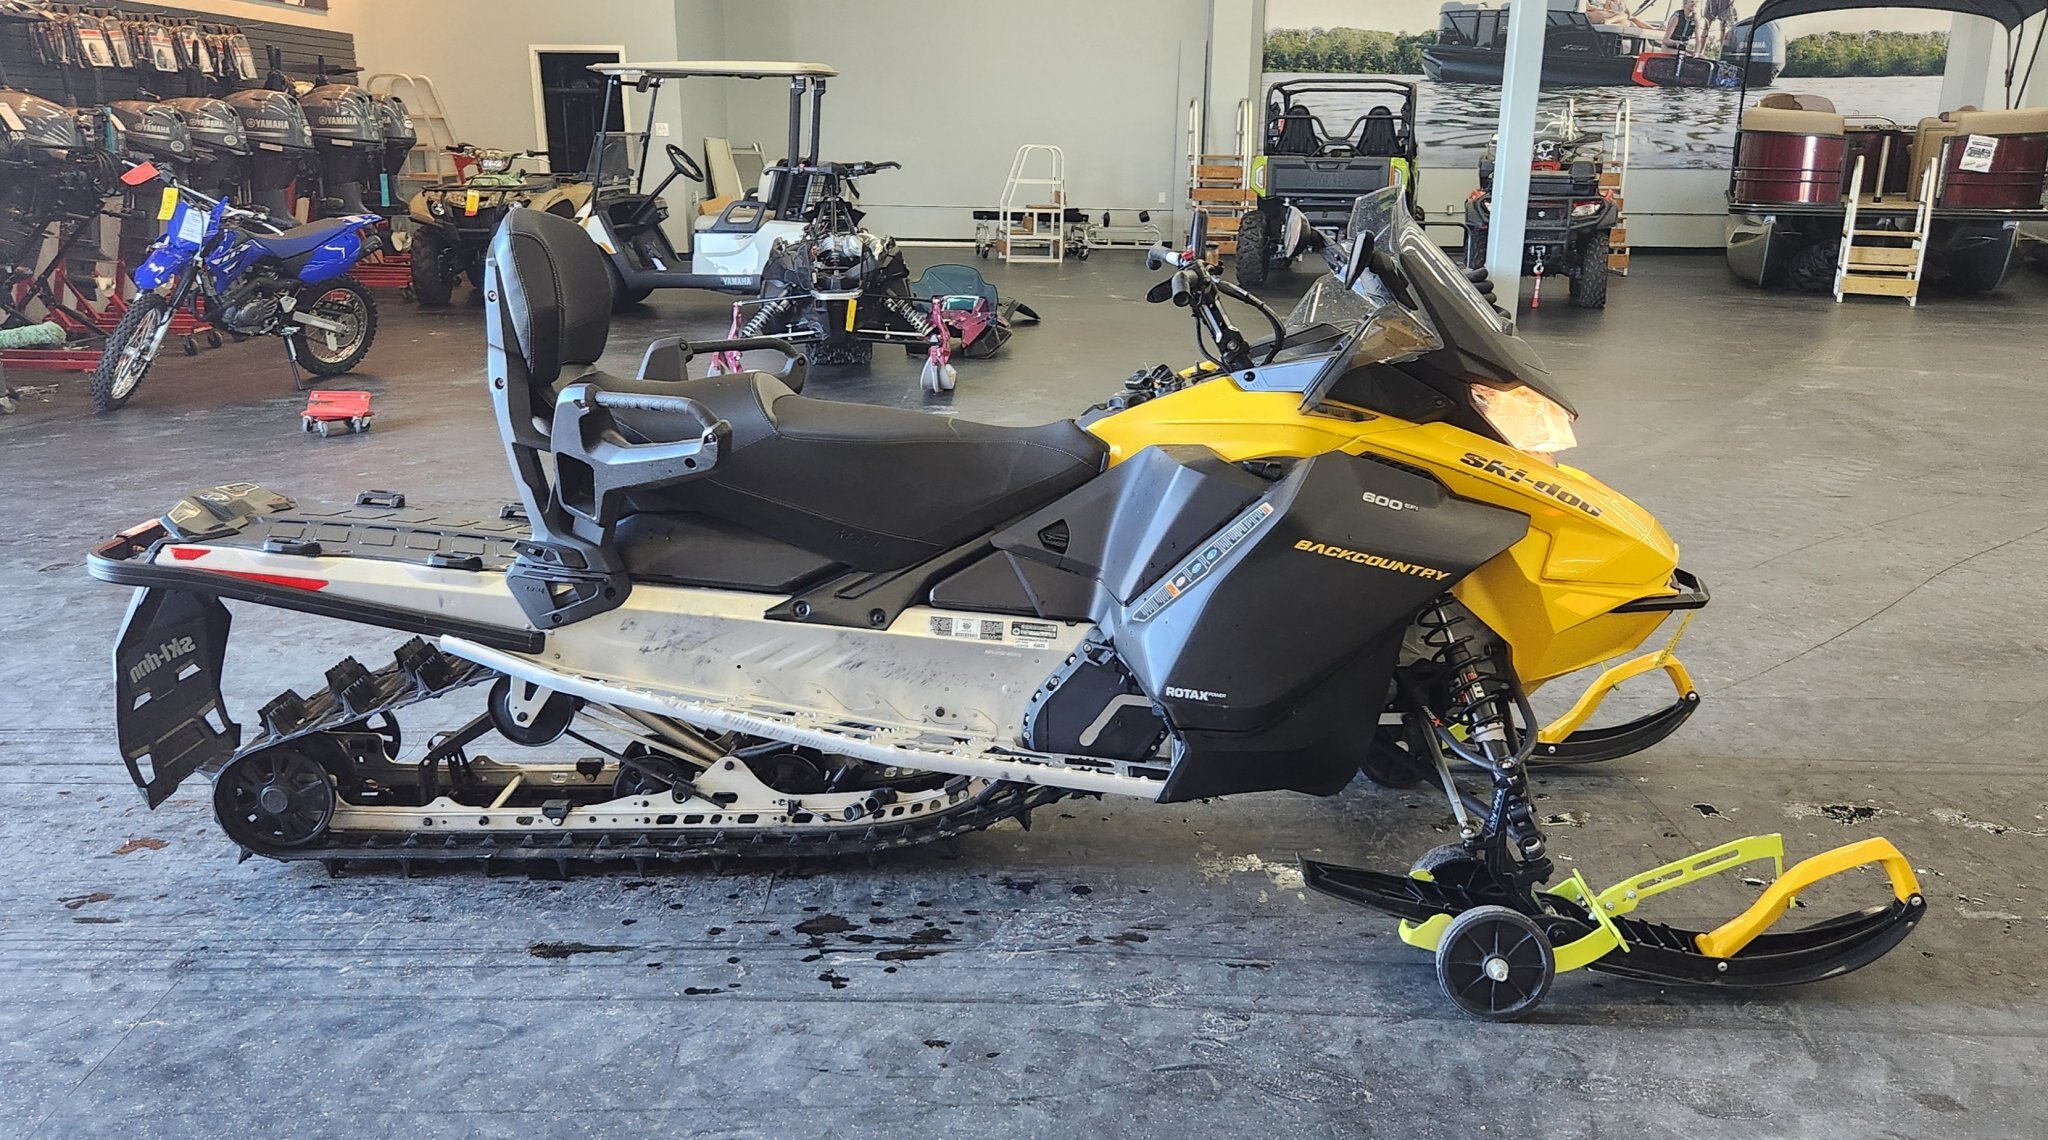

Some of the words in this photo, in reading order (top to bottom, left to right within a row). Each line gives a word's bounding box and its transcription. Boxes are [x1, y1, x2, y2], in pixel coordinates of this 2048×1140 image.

[197, 119, 225, 128] YAMAHA
[255, 118, 290, 130] YAMAHA
[327, 116, 358, 126] YAMAHA
[143, 123, 171, 134] YAMAHA
[720, 276, 752, 286] YAMAHA
[1362, 491, 1403, 511] 600
[1404, 502, 1420, 512] EFI
[1294, 539, 1452, 581] BACKCOUNTRY
[1165, 686, 1209, 702] ROTAX
